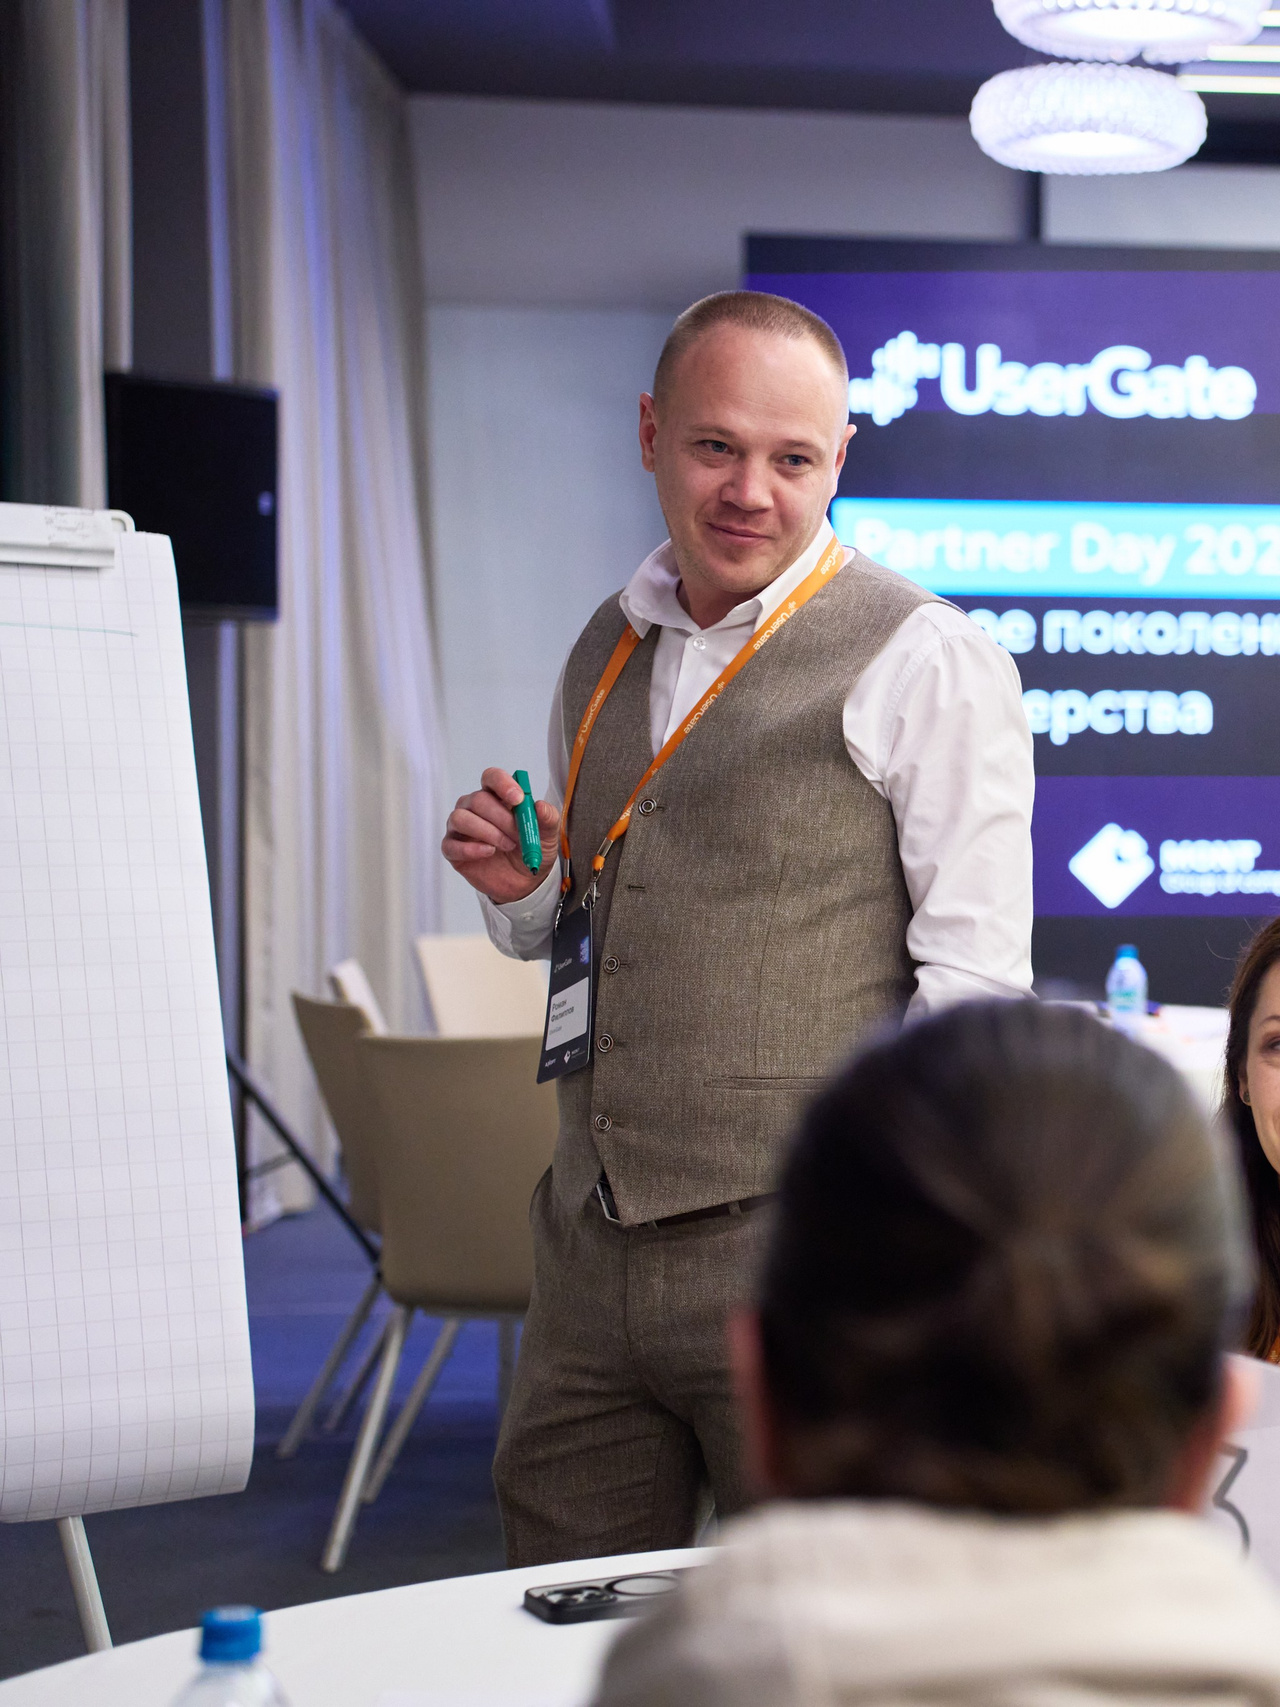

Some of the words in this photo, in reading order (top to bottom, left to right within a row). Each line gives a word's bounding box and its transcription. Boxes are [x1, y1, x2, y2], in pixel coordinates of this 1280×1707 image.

[941, 343, 1257, 420] UserGate
[853, 518, 1060, 573] Partner
[1071, 523, 1175, 586] Day
[752, 612, 790, 651] UserGate
[582, 689, 605, 734] UserGate
[684, 693, 717, 734] UserGate
